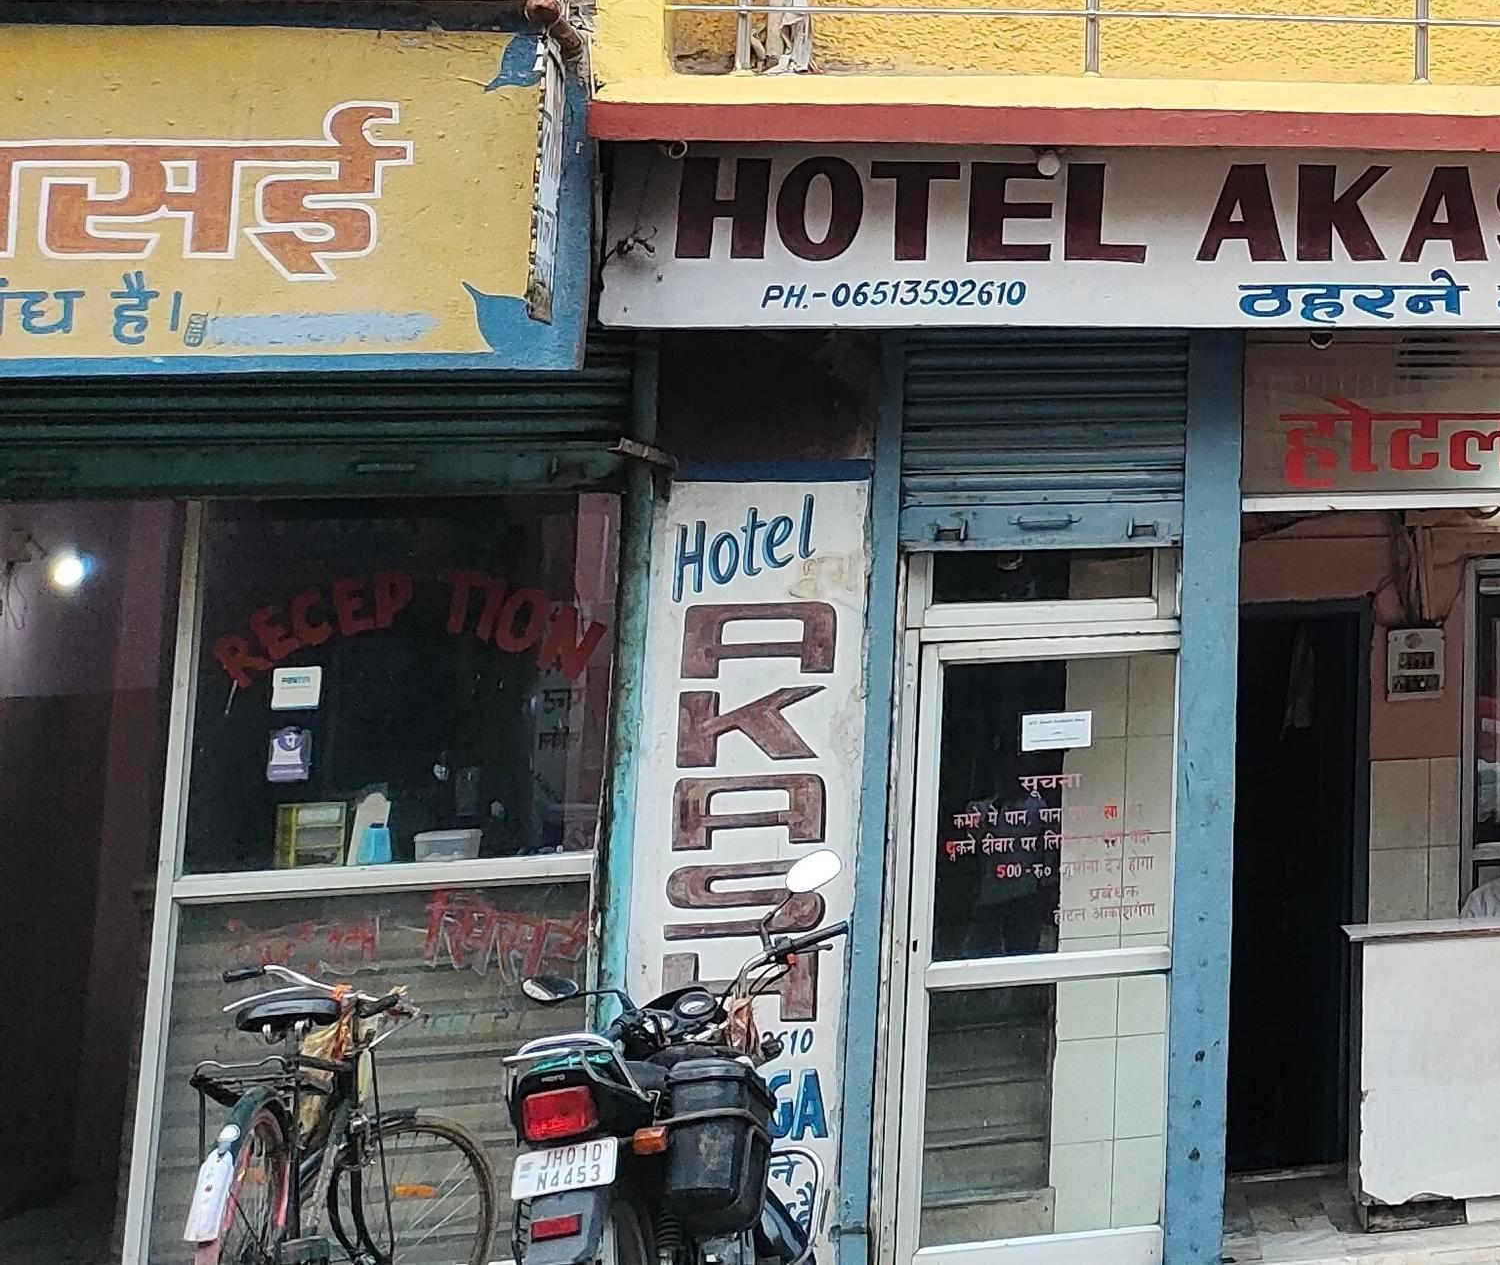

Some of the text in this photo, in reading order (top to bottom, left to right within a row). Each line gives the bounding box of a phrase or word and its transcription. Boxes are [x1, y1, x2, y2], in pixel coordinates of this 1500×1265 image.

[674, 156, 1148, 264] HOTEL
[1237, 270, 1469, 323] ठहरने
[671, 493, 817, 603] Hotel
